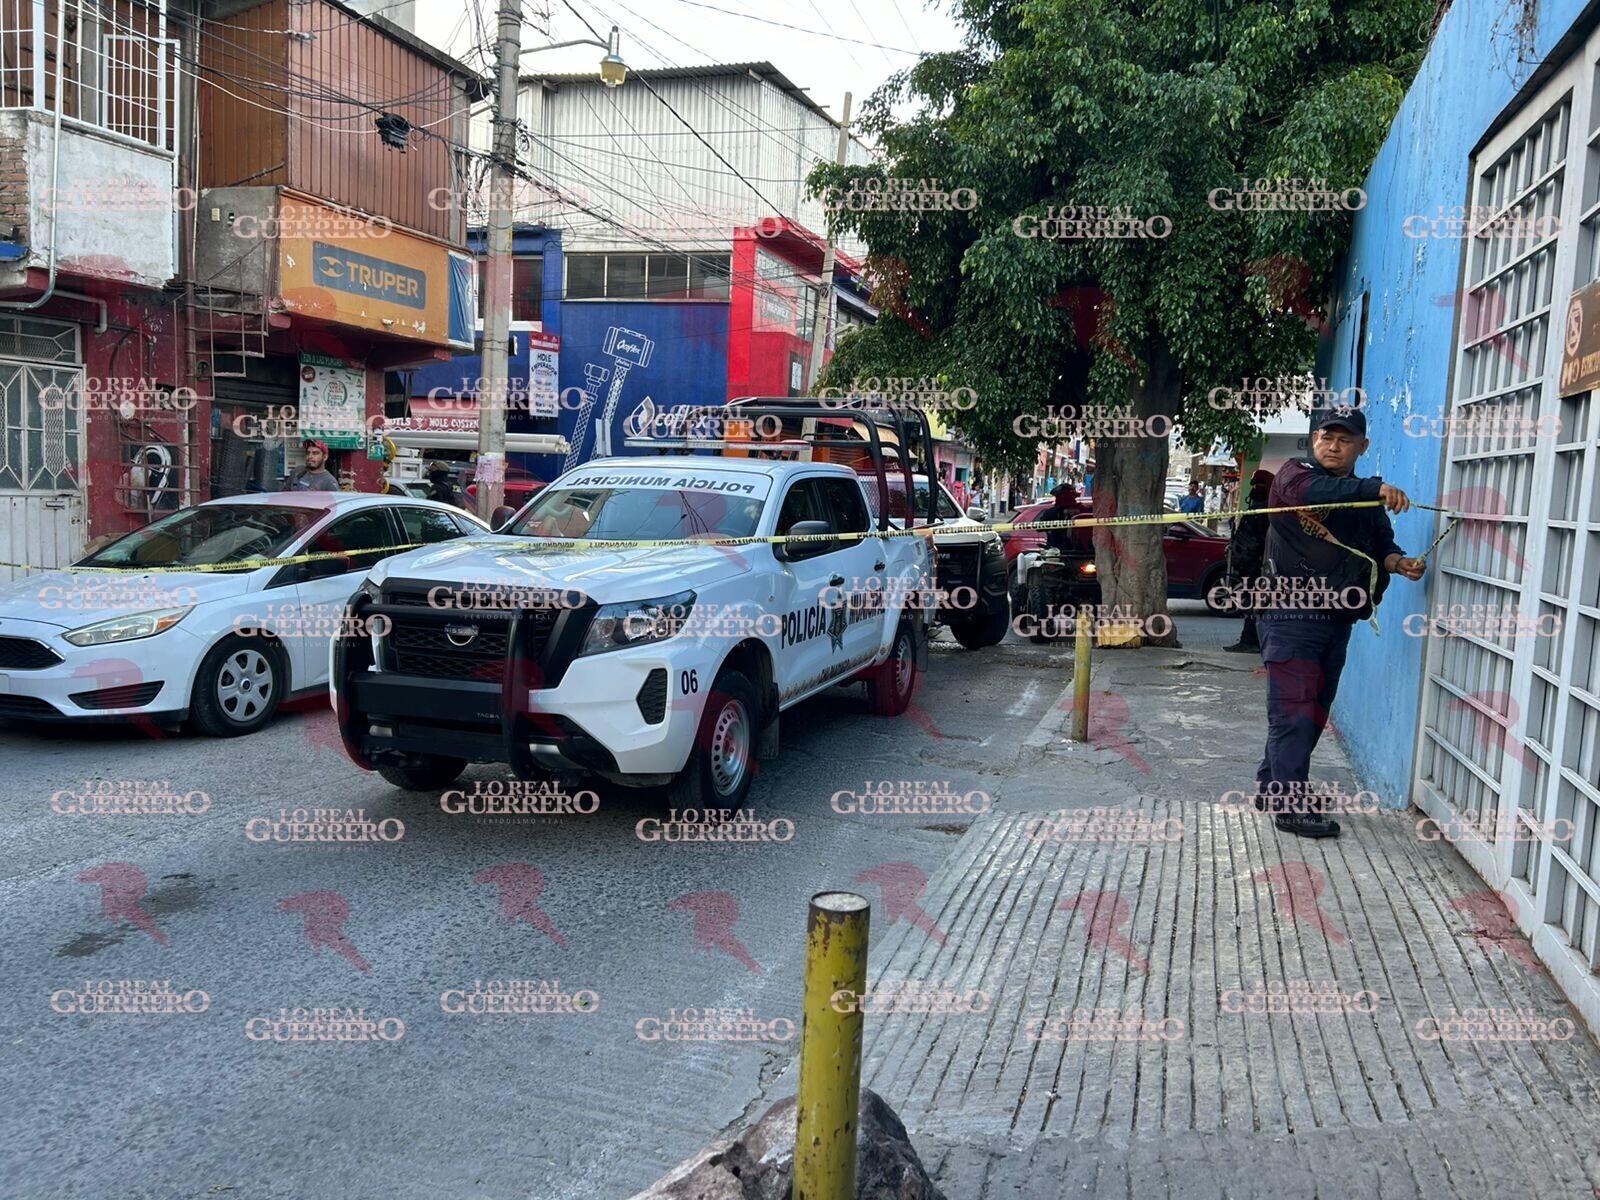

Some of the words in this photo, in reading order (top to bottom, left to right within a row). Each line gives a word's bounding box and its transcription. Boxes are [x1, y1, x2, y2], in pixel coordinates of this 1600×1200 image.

[346, 261, 419, 298] TRUPER
[655, 404, 707, 433] coflx
[781, 597, 826, 649] POLICÍA
[681, 669, 698, 695] 06
